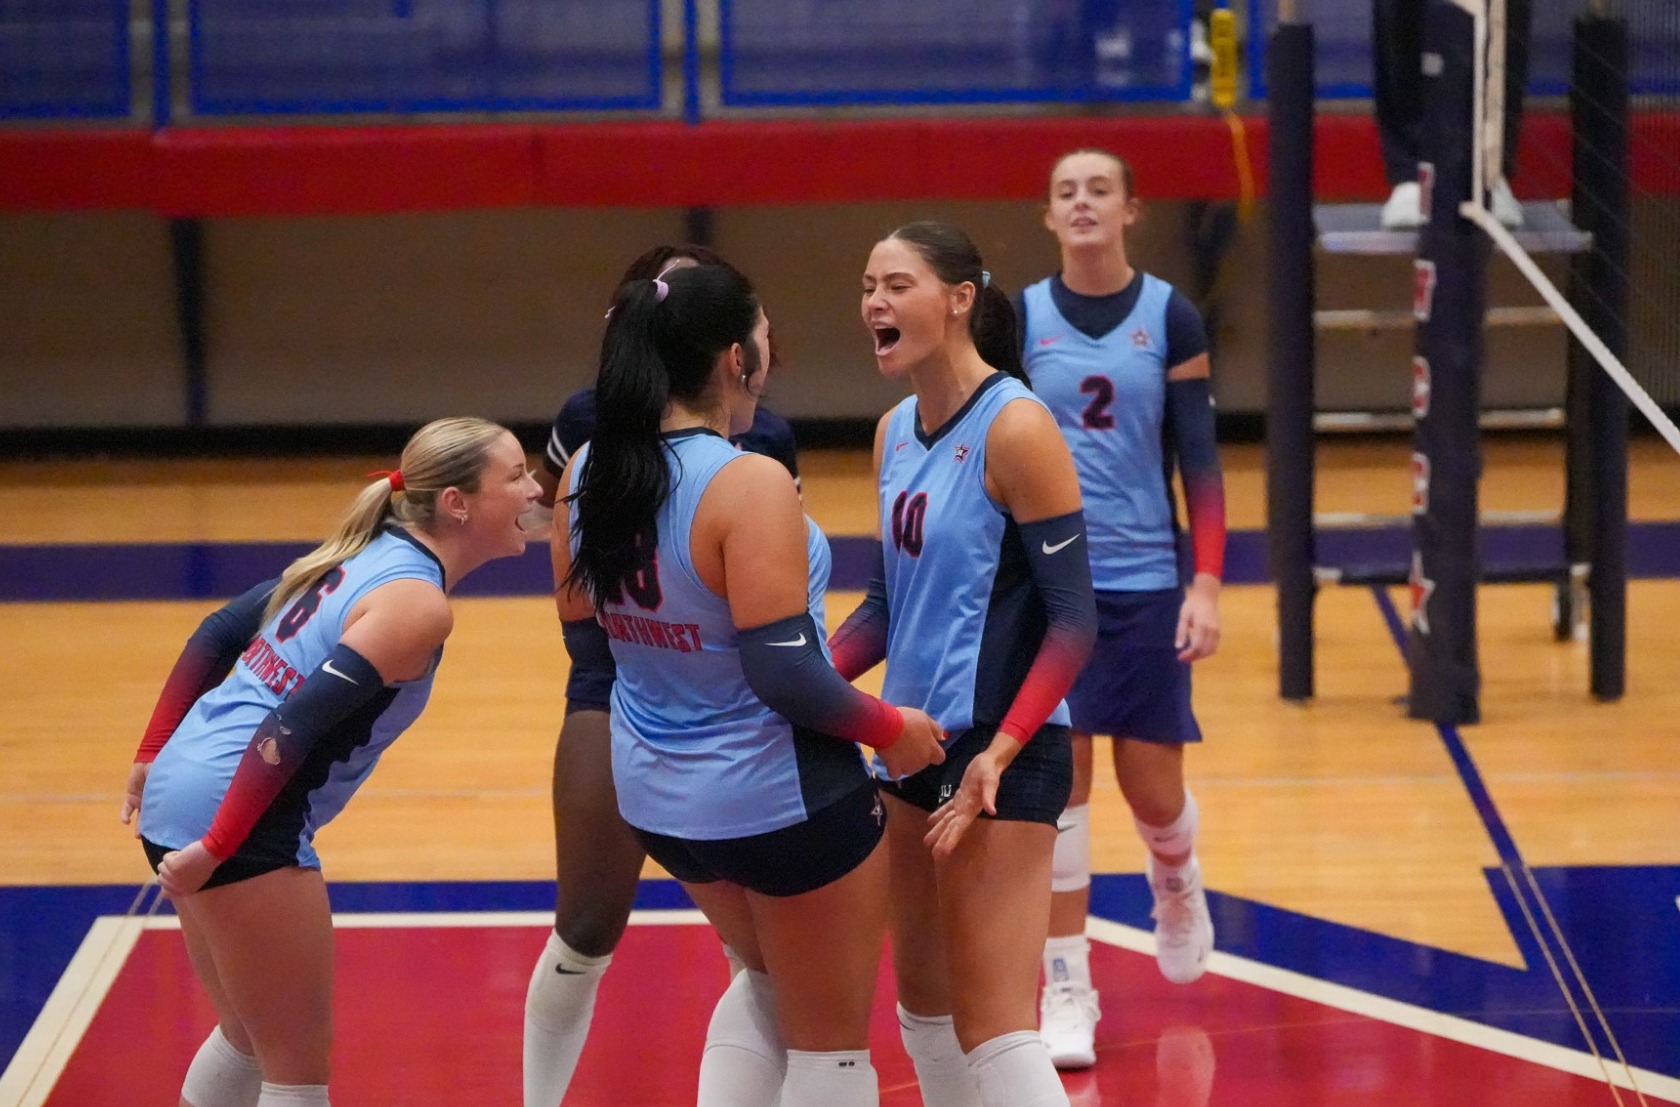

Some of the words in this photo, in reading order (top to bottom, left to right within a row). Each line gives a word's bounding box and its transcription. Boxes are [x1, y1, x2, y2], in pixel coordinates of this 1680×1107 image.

[1079, 373, 1117, 432] 2
[891, 490, 929, 558] 10
[275, 564, 346, 644] 6
[597, 609, 704, 653] ORTHWEST
